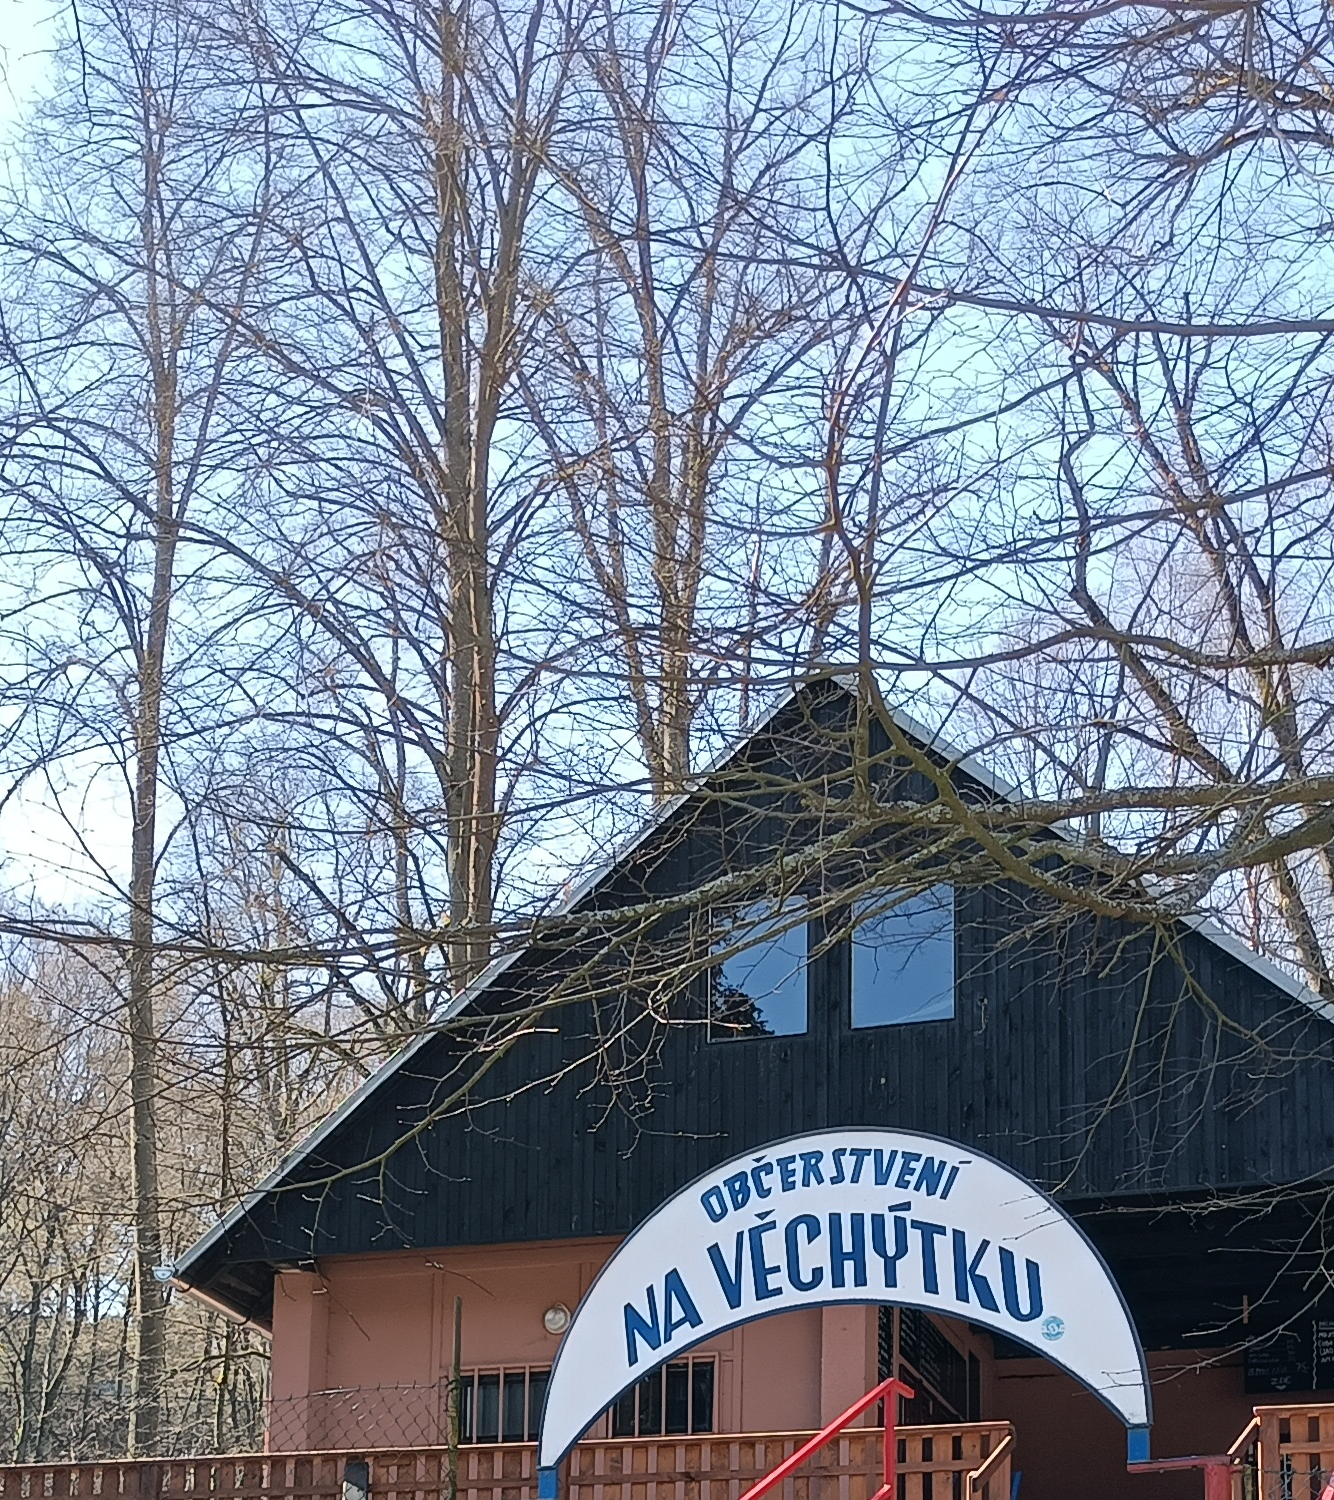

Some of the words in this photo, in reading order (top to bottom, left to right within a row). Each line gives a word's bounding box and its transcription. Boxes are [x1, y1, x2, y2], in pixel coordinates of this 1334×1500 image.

[699, 1147, 973, 1224] OBČERSTVENÍ
[622, 1266, 704, 1368] NA
[706, 1199, 1045, 1323] VĚCHÝTKU
